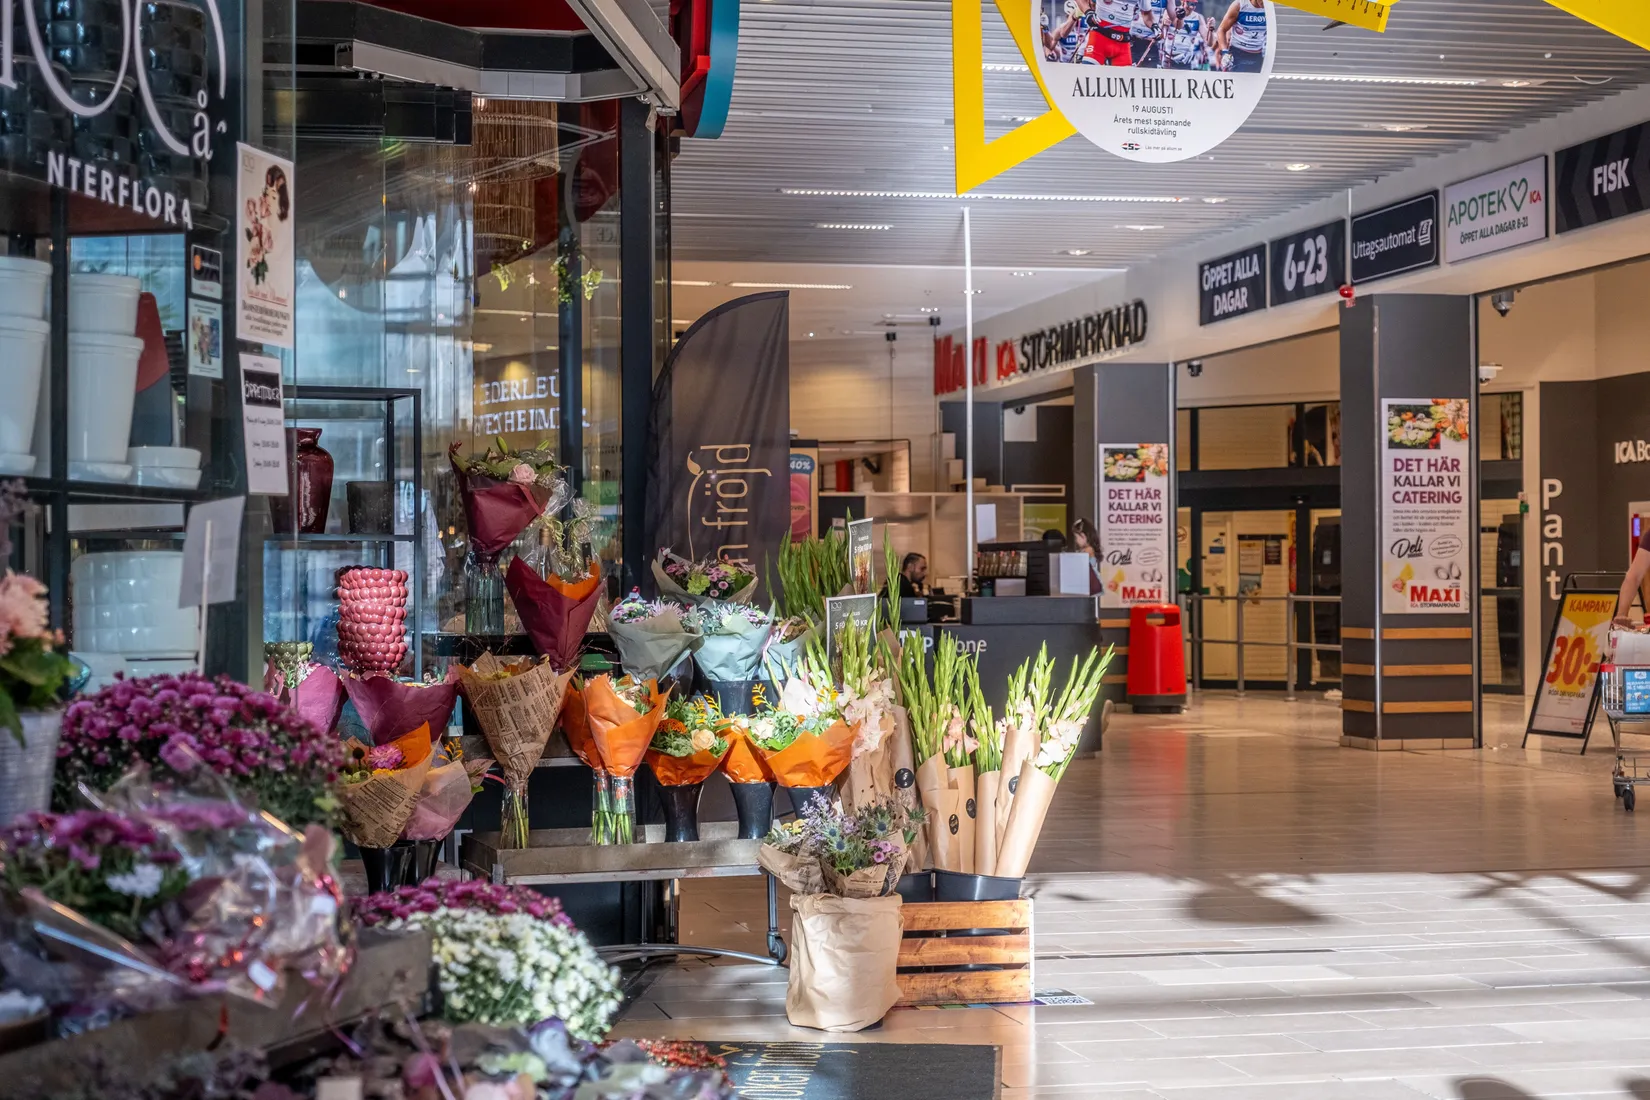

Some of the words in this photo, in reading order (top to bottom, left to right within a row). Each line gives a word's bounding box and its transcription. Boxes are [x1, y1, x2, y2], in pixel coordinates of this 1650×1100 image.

[1072, 77, 1136, 98] ALLUM
[1142, 78, 1182, 98] HILL
[1187, 78, 1234, 100] RACE
[1114, 114, 1132, 124] Årets
[1154, 118, 1191, 127] spännande
[1141, 106, 1173, 114] AUGUSTI
[1128, 127, 1176, 138] rullskidtävling
[1594, 158, 1630, 196] FISK
[1448, 188, 1506, 228] APOTEK
[1530, 190, 1542, 204] ICA
[1353, 226, 1416, 260] Uttagsautomat
[1460, 230, 1478, 244] ÖPPET
[1479, 226, 1494, 239] ALLA
[1495, 220, 1516, 235] DAGAR
[1202, 264, 1233, 291] ÖPPET
[1234, 254, 1260, 282] ALLA
[1284, 234, 1327, 292] 6-23
[1214, 287, 1248, 316] DAGAR
[996, 340, 1018, 380] ICA
[1018, 298, 1148, 374] STORMARKNAD
[1394, 458, 1424, 472] DET
[1427, 456, 1461, 472] HÄR
[700, 444, 772, 530] fröjd
[1394, 475, 1444, 487] KALLAR
[1447, 475, 1460, 487] VI
[1109, 488, 1132, 500] DET
[1135, 487, 1161, 500] HÄR
[1392, 490, 1462, 504] CATERING
[1108, 502, 1149, 512] KALLAR
[1151, 502, 1161, 511] VI
[1108, 514, 1163, 524] CATERING
[1391, 536, 1423, 558] Deli
[1543, 478, 1562, 600] Pant
[1107, 548, 1132, 565] Deli
[1569, 600, 1612, 613] KAMPANJ
